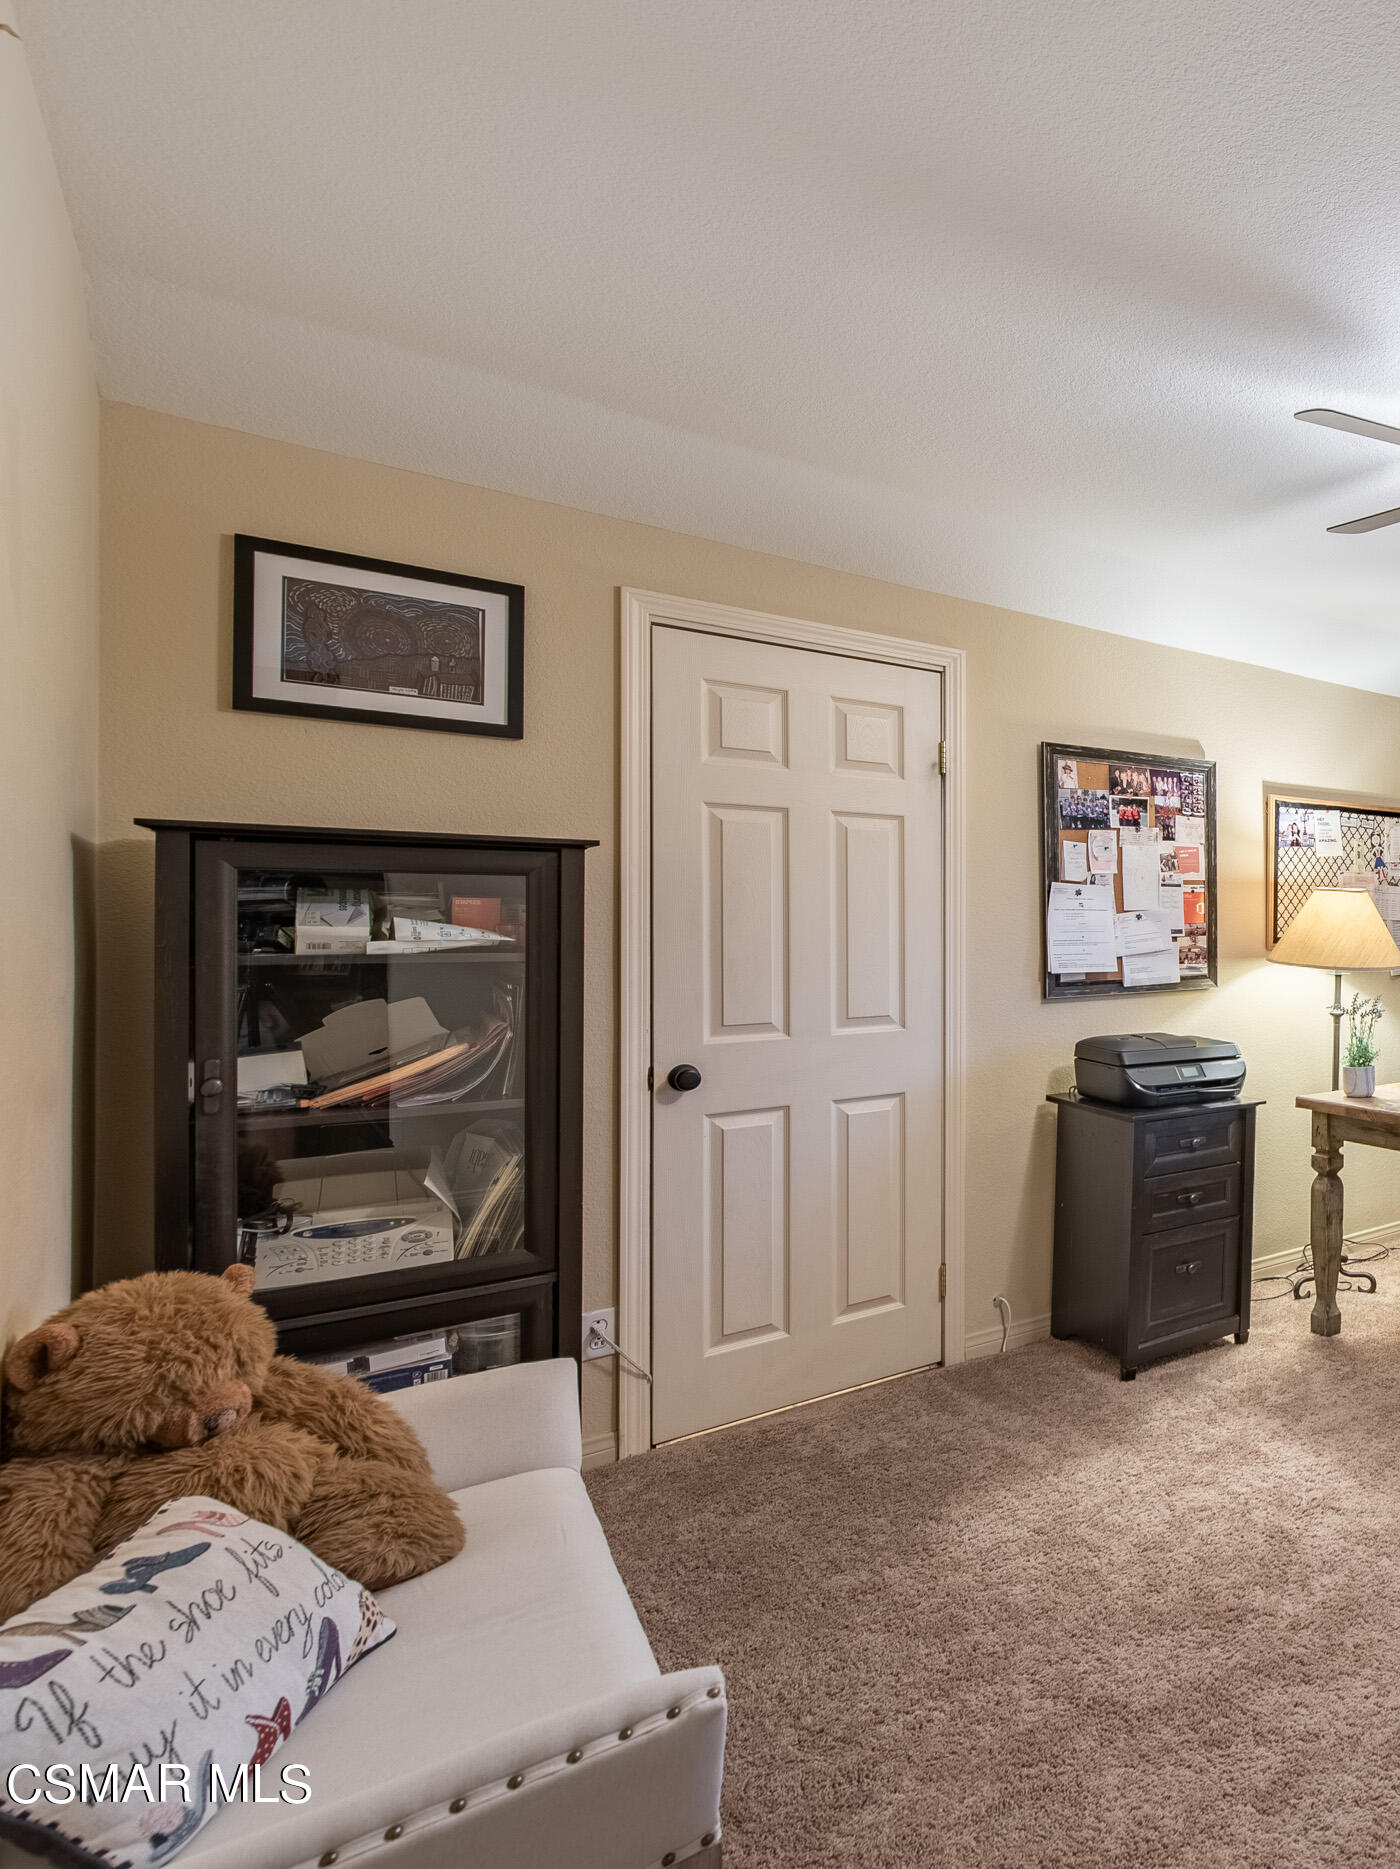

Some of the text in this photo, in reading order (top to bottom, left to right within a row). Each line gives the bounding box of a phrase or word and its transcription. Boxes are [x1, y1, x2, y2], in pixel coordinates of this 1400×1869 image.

[15, 1680, 103, 1749] If
[89, 1640, 167, 1688] the
[166, 1579, 237, 1644] shoe
[178, 1670, 221, 1720] it
[211, 1658, 254, 1692] in
[254, 1602, 314, 1663] every
